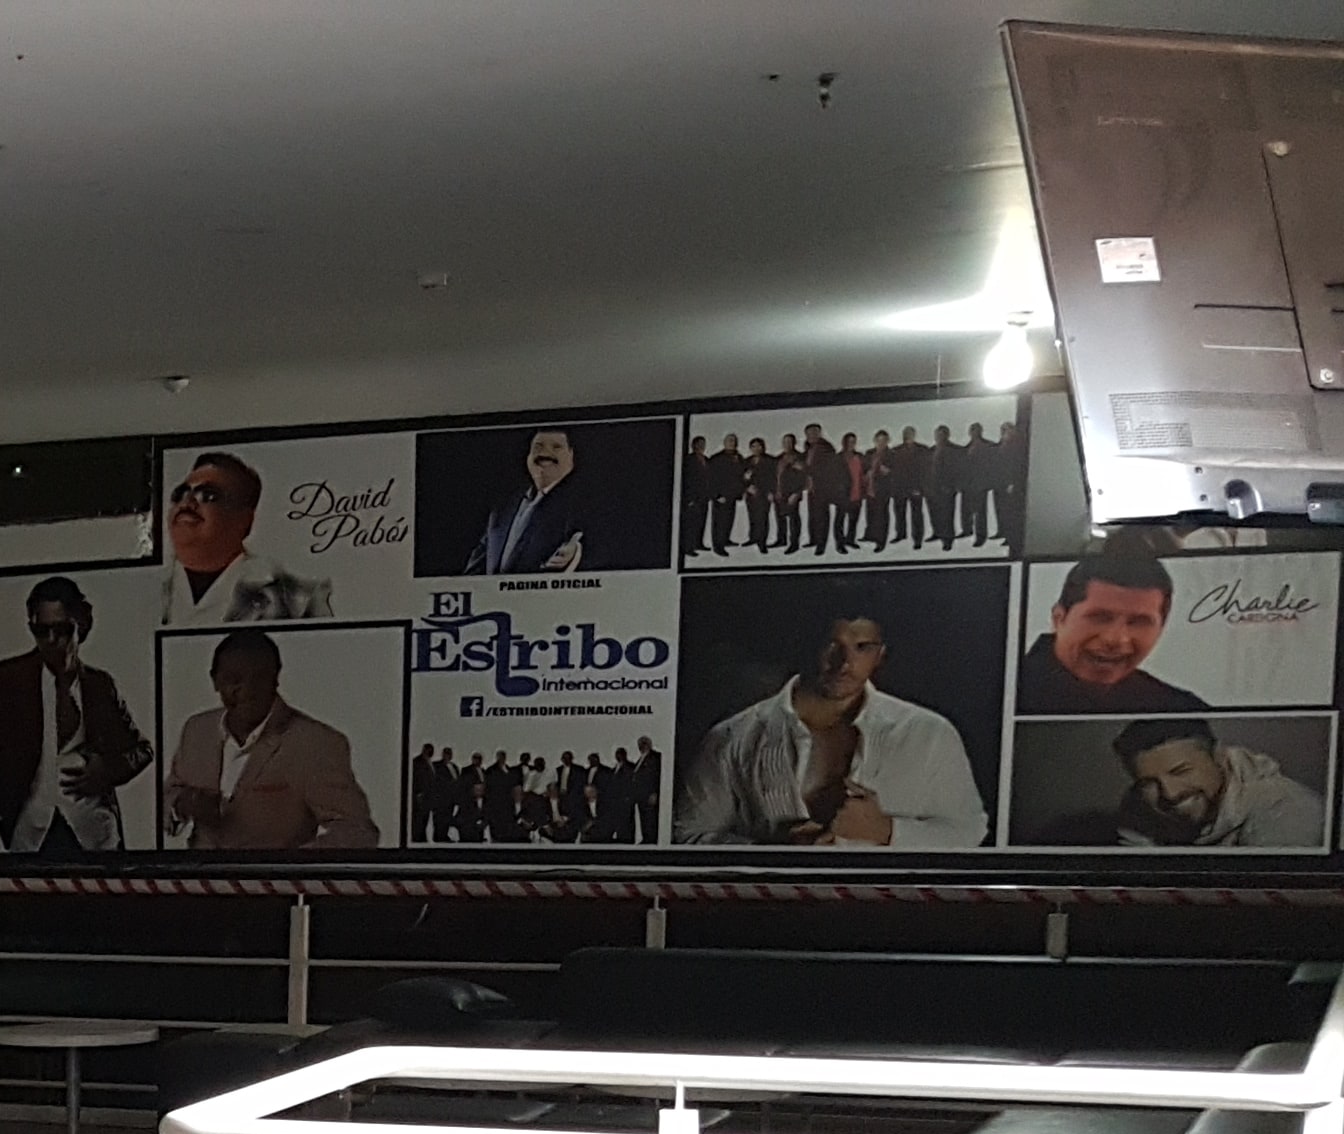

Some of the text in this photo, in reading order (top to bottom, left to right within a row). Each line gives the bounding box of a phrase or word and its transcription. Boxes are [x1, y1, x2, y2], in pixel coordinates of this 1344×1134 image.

[288, 478, 394, 520] David
[429, 591, 474, 618] El
[499, 578, 602, 591] PAGINA OFICIAL
[1188, 578, 1320, 623] Charlie
[412, 612, 670, 697] Estribo
